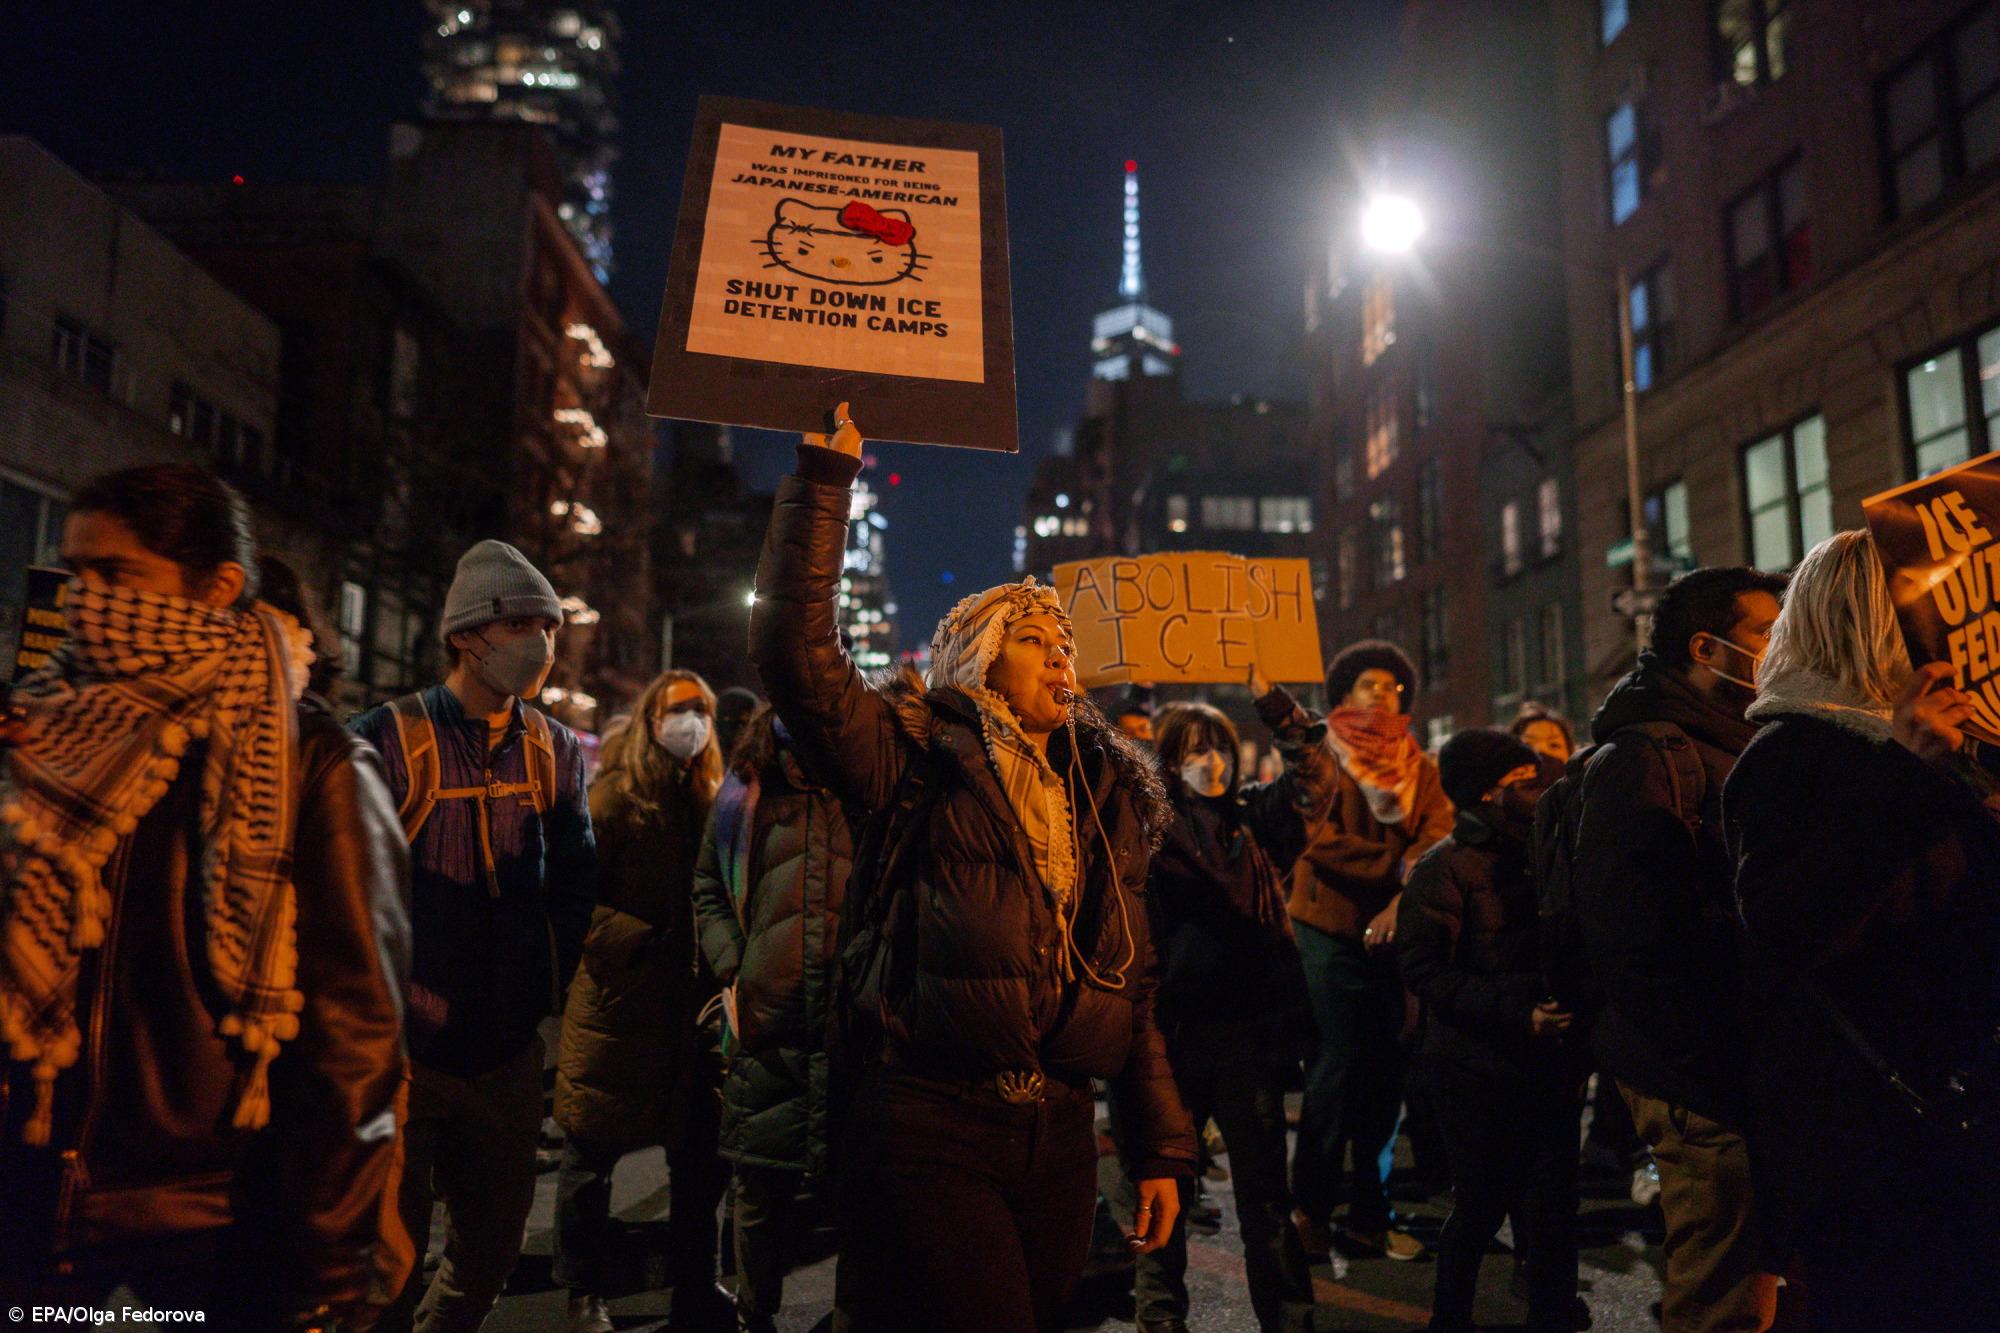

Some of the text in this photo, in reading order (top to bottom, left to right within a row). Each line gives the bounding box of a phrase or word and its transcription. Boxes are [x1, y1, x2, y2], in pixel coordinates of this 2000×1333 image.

[751, 162, 941, 191] WAS IMPRISONED FOR BEING
[770, 144, 926, 173] MY FATHER
[731, 174, 958, 206] JAPANESE-AMERICAN
[726, 279, 941, 318] SHUT DOWN ICE
[724, 299, 948, 337] DETENTION CAMPS
[1915, 490, 1993, 561] ICE
[1068, 561, 1302, 623] ABOLISH
